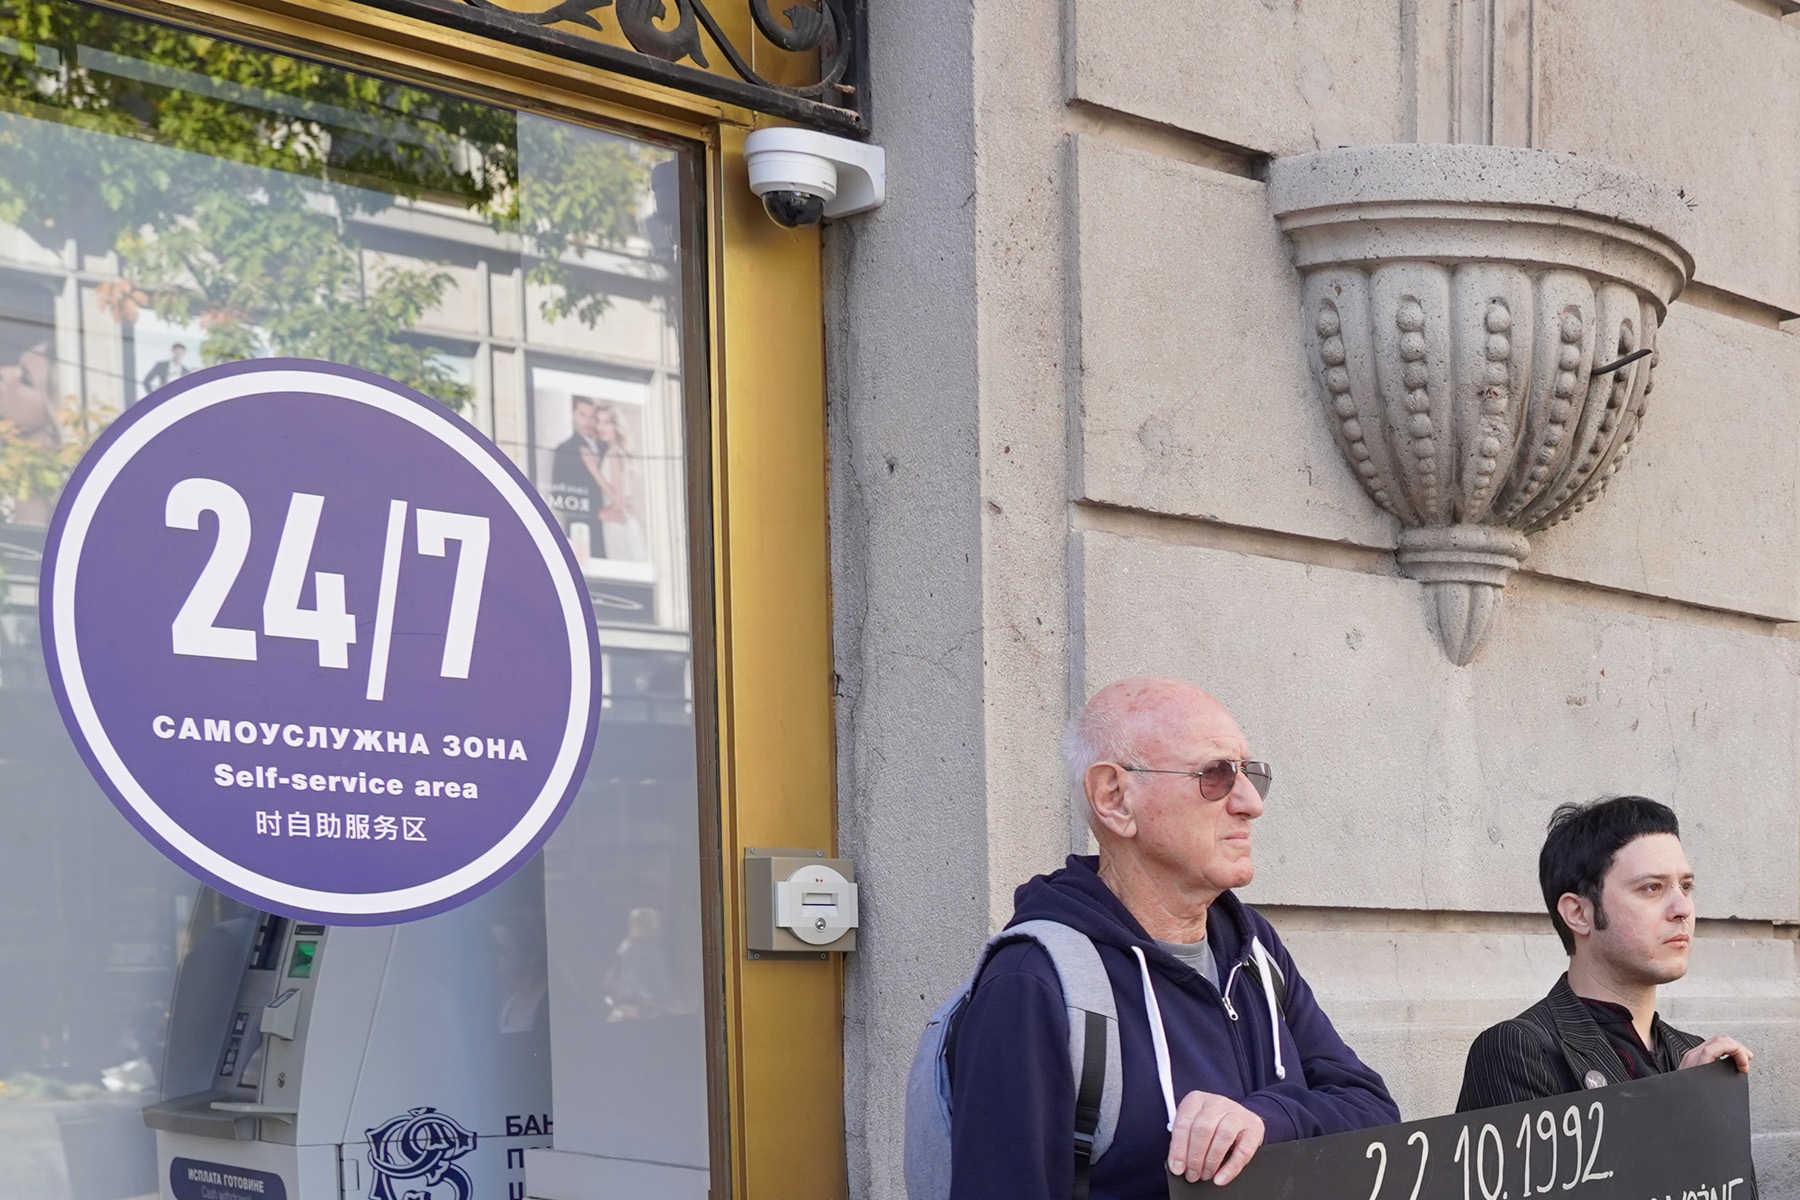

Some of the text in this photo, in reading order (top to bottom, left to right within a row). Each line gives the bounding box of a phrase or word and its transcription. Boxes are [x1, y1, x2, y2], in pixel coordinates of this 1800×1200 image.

[165, 476, 490, 702] 24/7
[152, 715, 528, 761] САМОУСЛУЖНА ЗОНА
[214, 763, 479, 799] Self-service area
[255, 809, 428, 843] 时自助服务区
[201, 1185, 217, 1199] Cash
[223, 1174, 264, 1193] ГОТОВИНЕ
